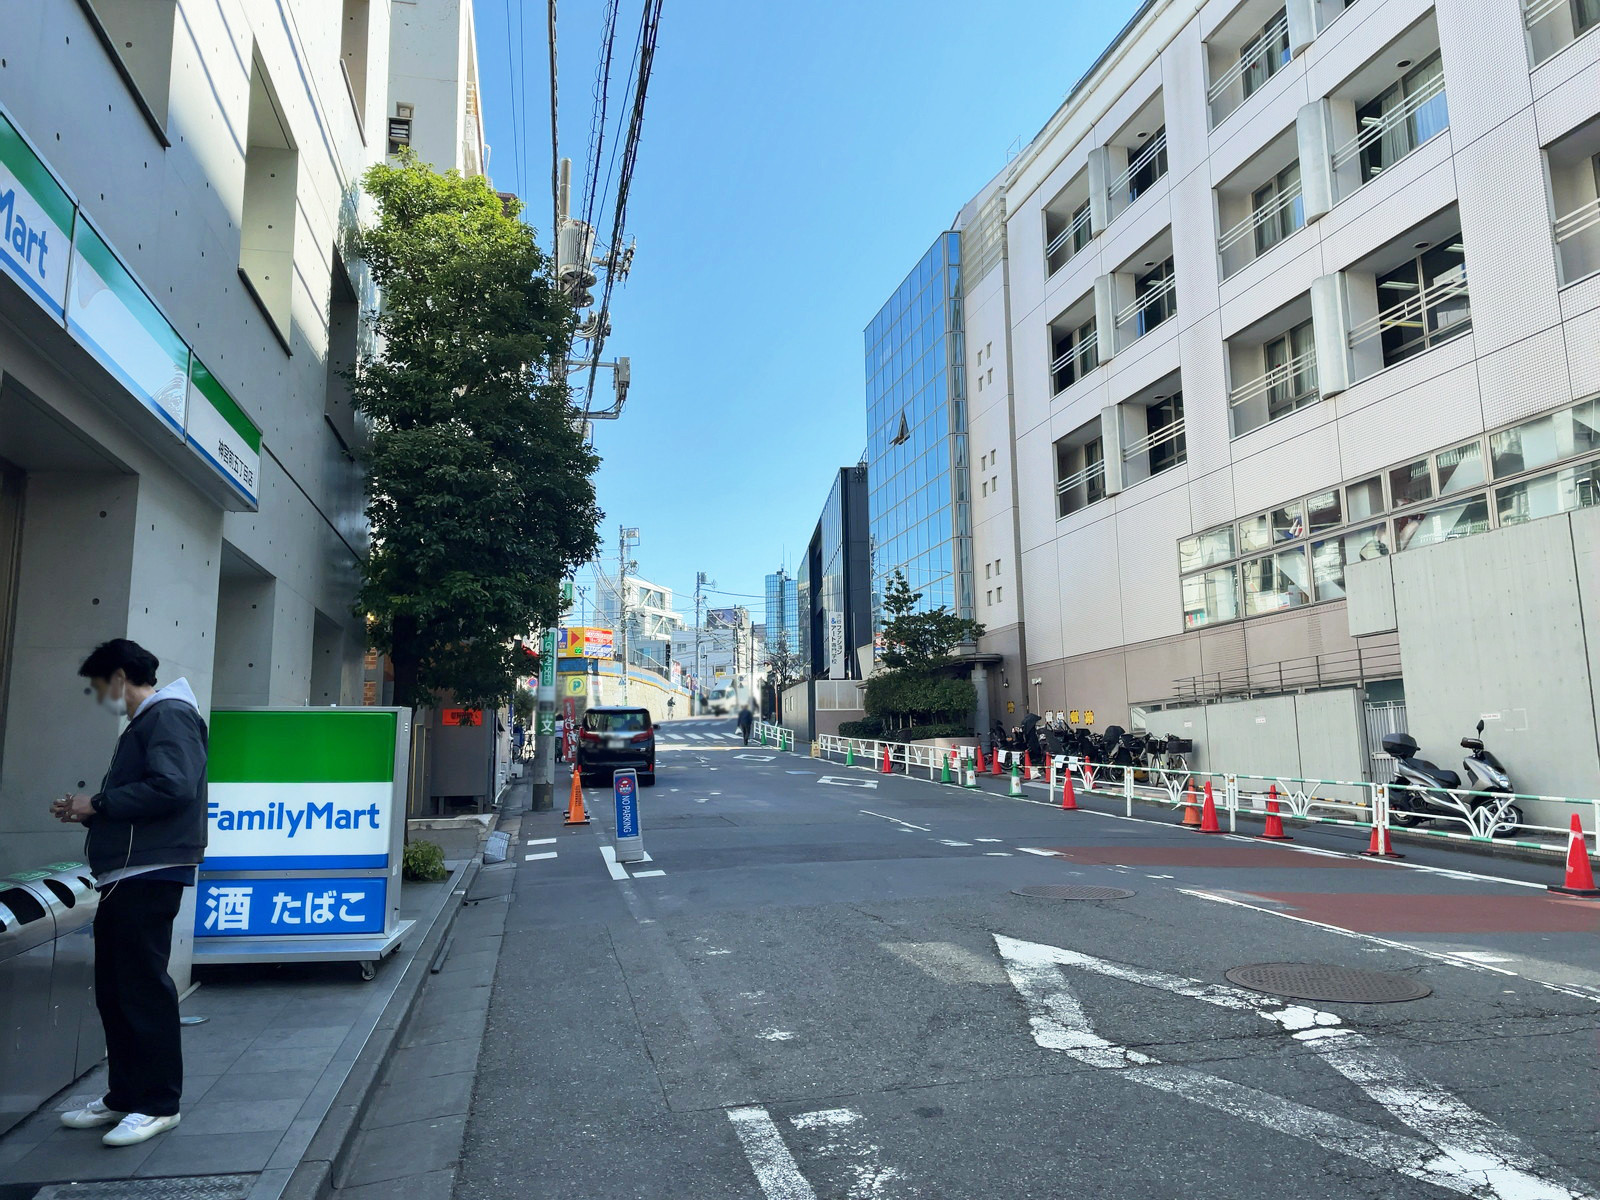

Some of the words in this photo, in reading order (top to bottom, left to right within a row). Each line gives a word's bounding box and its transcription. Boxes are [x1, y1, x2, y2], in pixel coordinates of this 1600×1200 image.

[541, 719, 553, 732] 文
[622, 795, 631, 806] NO
[207, 802, 380, 838] FamilyMart
[622, 806, 632, 833] PARKING
[203, 886, 253, 931] 酒
[270, 891, 366, 924] たばこ
